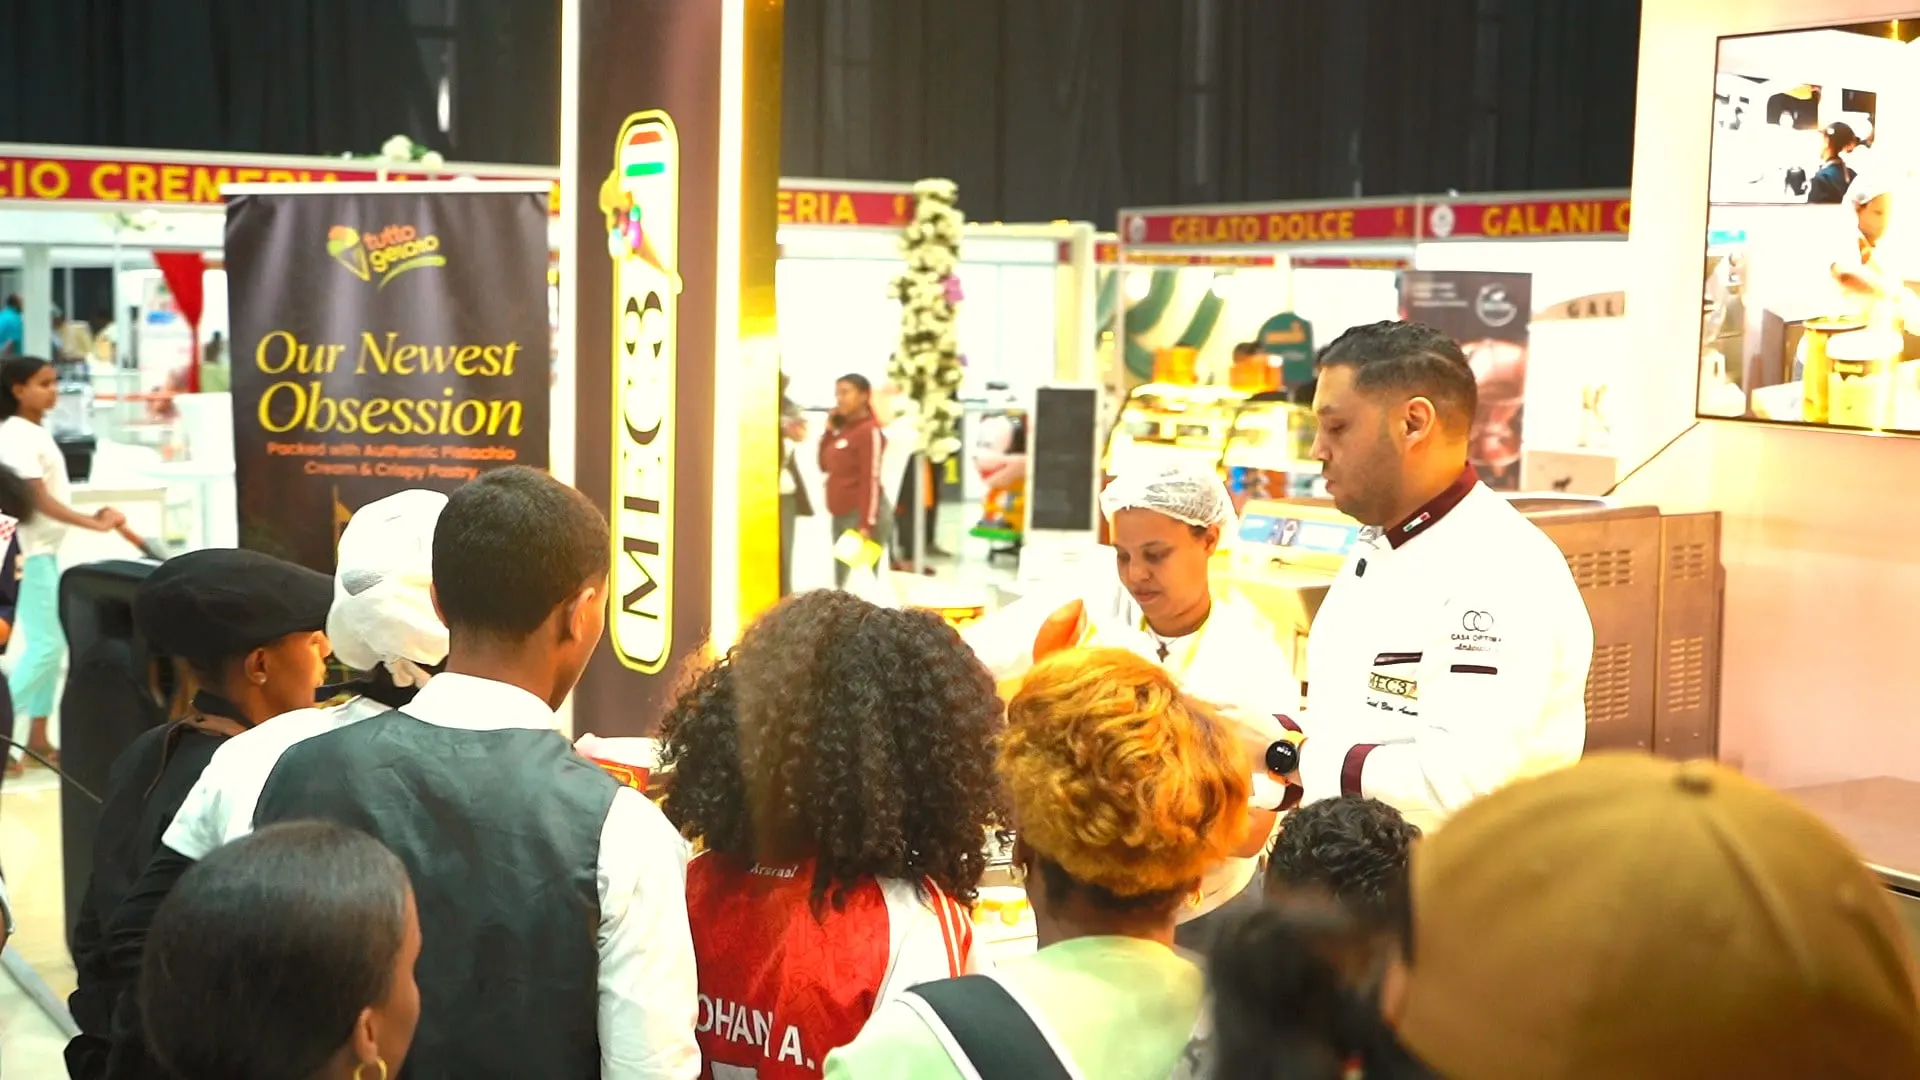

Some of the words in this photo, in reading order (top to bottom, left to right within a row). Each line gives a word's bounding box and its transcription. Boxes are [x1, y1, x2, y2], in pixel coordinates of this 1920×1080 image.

[0, 160, 70, 198] IO
[1170, 215, 1261, 243] GELATO
[1267, 211, 1354, 242] DOLCE
[1482, 203, 1601, 237] GALANI
[1566, 300, 1625, 318] GAL
[255, 330, 347, 375] Our
[354, 331, 523, 377] Newest
[258, 381, 524, 437] Obsession
[267, 441, 326, 457] Packed
[364, 443, 439, 459] Authentic
[304, 460, 358, 475] Cream
[1450, 633, 1470, 641] CASA
[778, 1025, 815, 1070] A.
